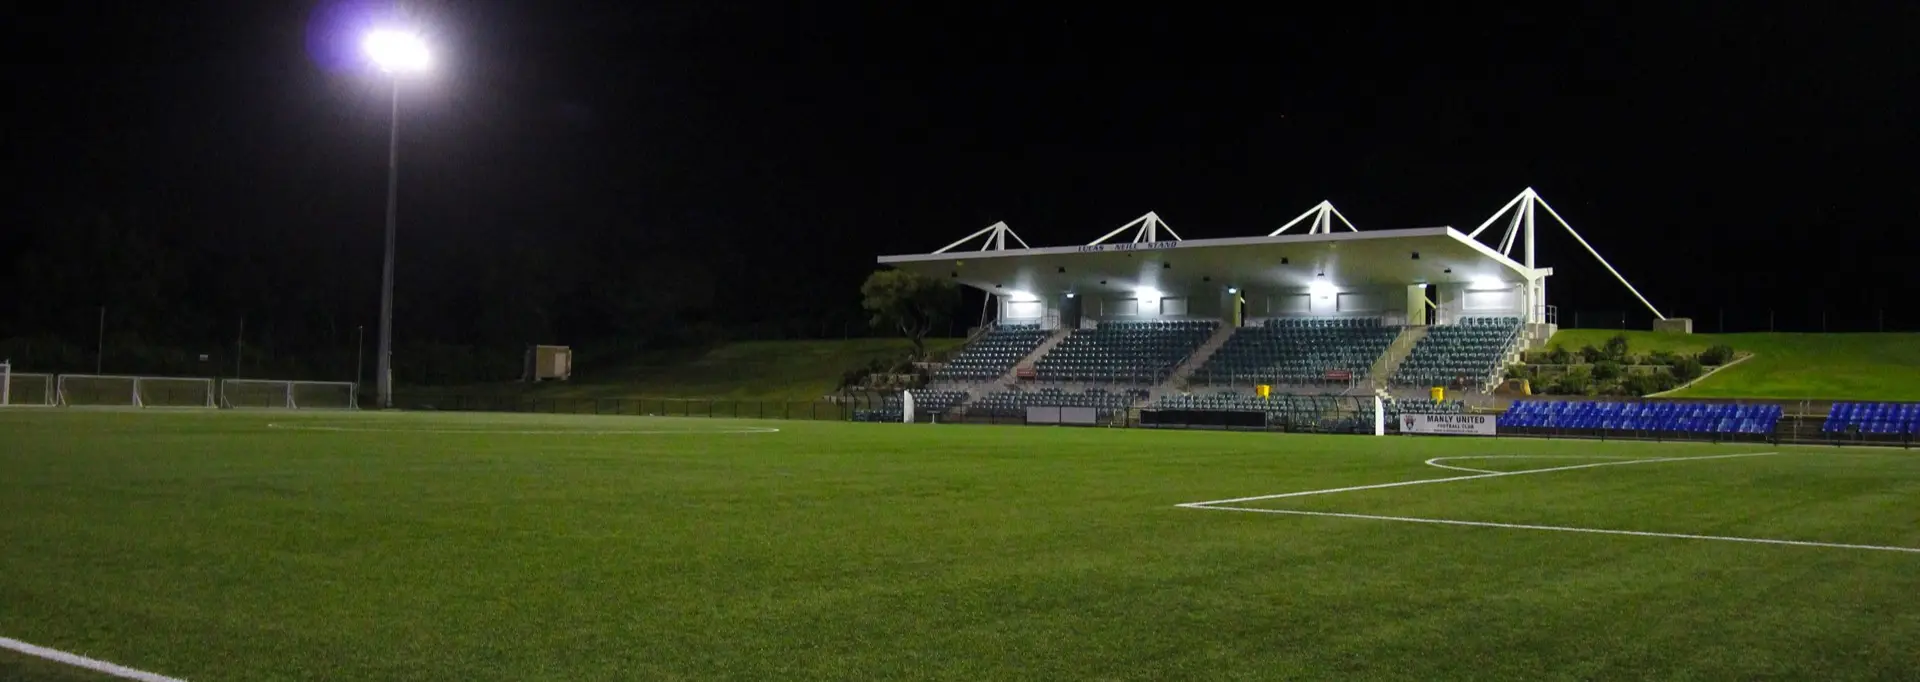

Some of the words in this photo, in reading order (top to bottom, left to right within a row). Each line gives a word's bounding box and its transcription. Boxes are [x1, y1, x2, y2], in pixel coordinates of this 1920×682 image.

[1147, 241, 1177, 249] STAND
[1427, 415, 1453, 423] MANLY
[1456, 415, 1485, 424] UNITED
